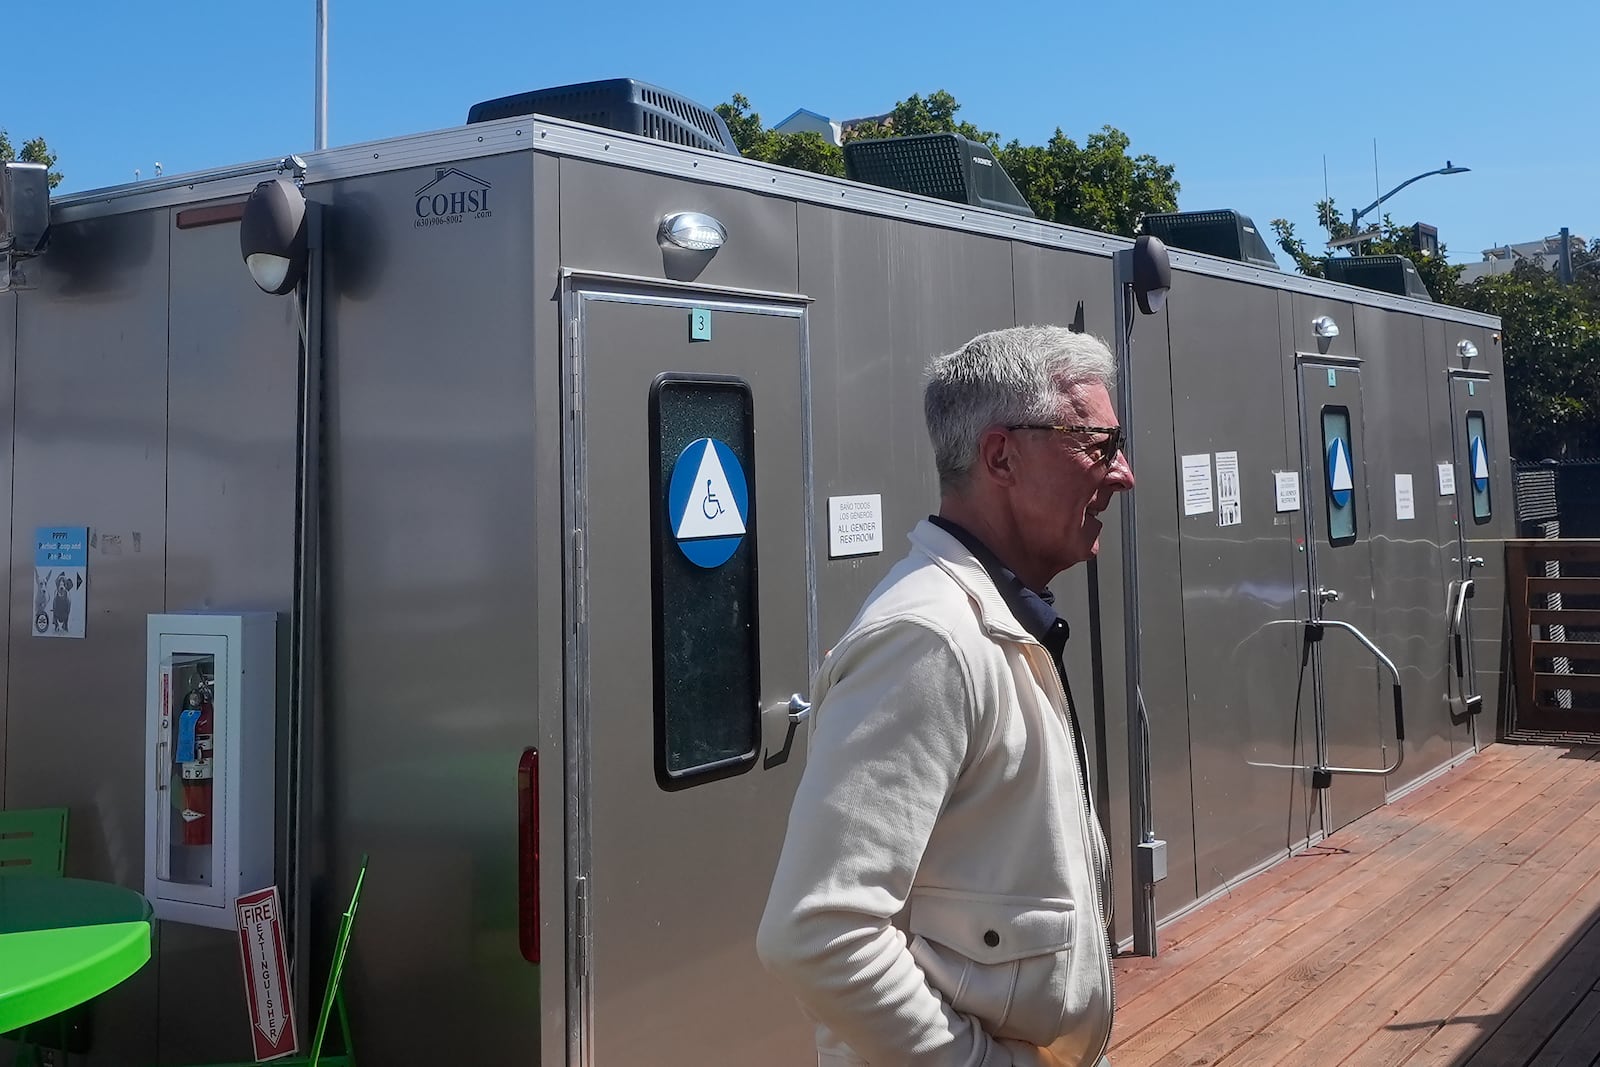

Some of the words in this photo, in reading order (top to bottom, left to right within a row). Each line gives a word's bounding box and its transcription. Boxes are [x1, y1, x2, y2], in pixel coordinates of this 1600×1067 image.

[415, 189, 489, 217] COHSI
[474, 211, 492, 219] .com
[698, 315, 705, 331] 3
[839, 511, 850, 521] LOS
[838, 524, 849, 533] ALL
[851, 522, 876, 532] GENDER
[840, 533, 874, 543] RESTROOM
[244, 903, 272, 925] FIRE
[256, 922, 277, 1037] EXTINGUISHER
